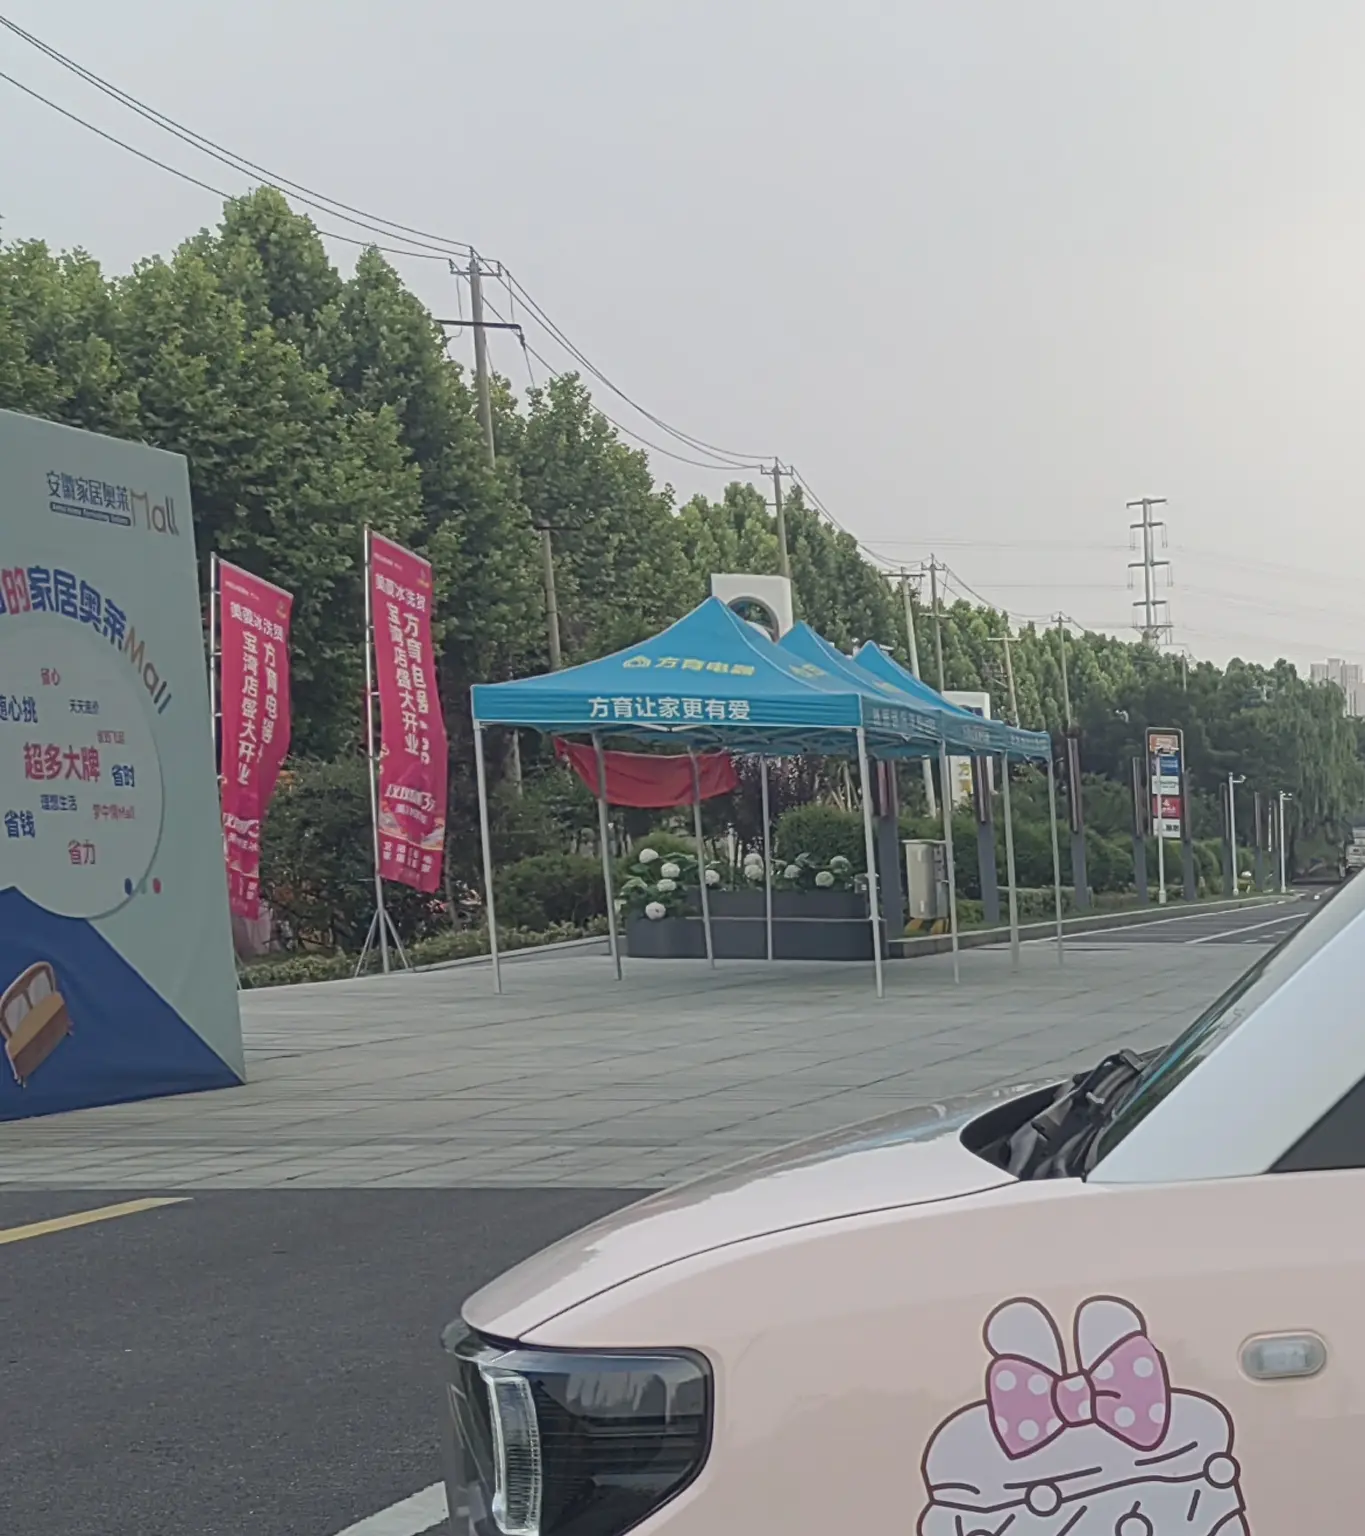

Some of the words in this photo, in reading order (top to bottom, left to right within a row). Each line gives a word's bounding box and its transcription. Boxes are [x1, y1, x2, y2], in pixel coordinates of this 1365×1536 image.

[0, 565, 172, 715] 的家居奥莱Mall
[655, 656, 755, 677] 方育电器
[588, 696, 750, 720] 方育让家更有爱
[23, 742, 101, 782] 超多大牌
[112, 764, 135, 788] 省时
[5, 809, 36, 838] 省钱
[68, 839, 96, 865] 省力
